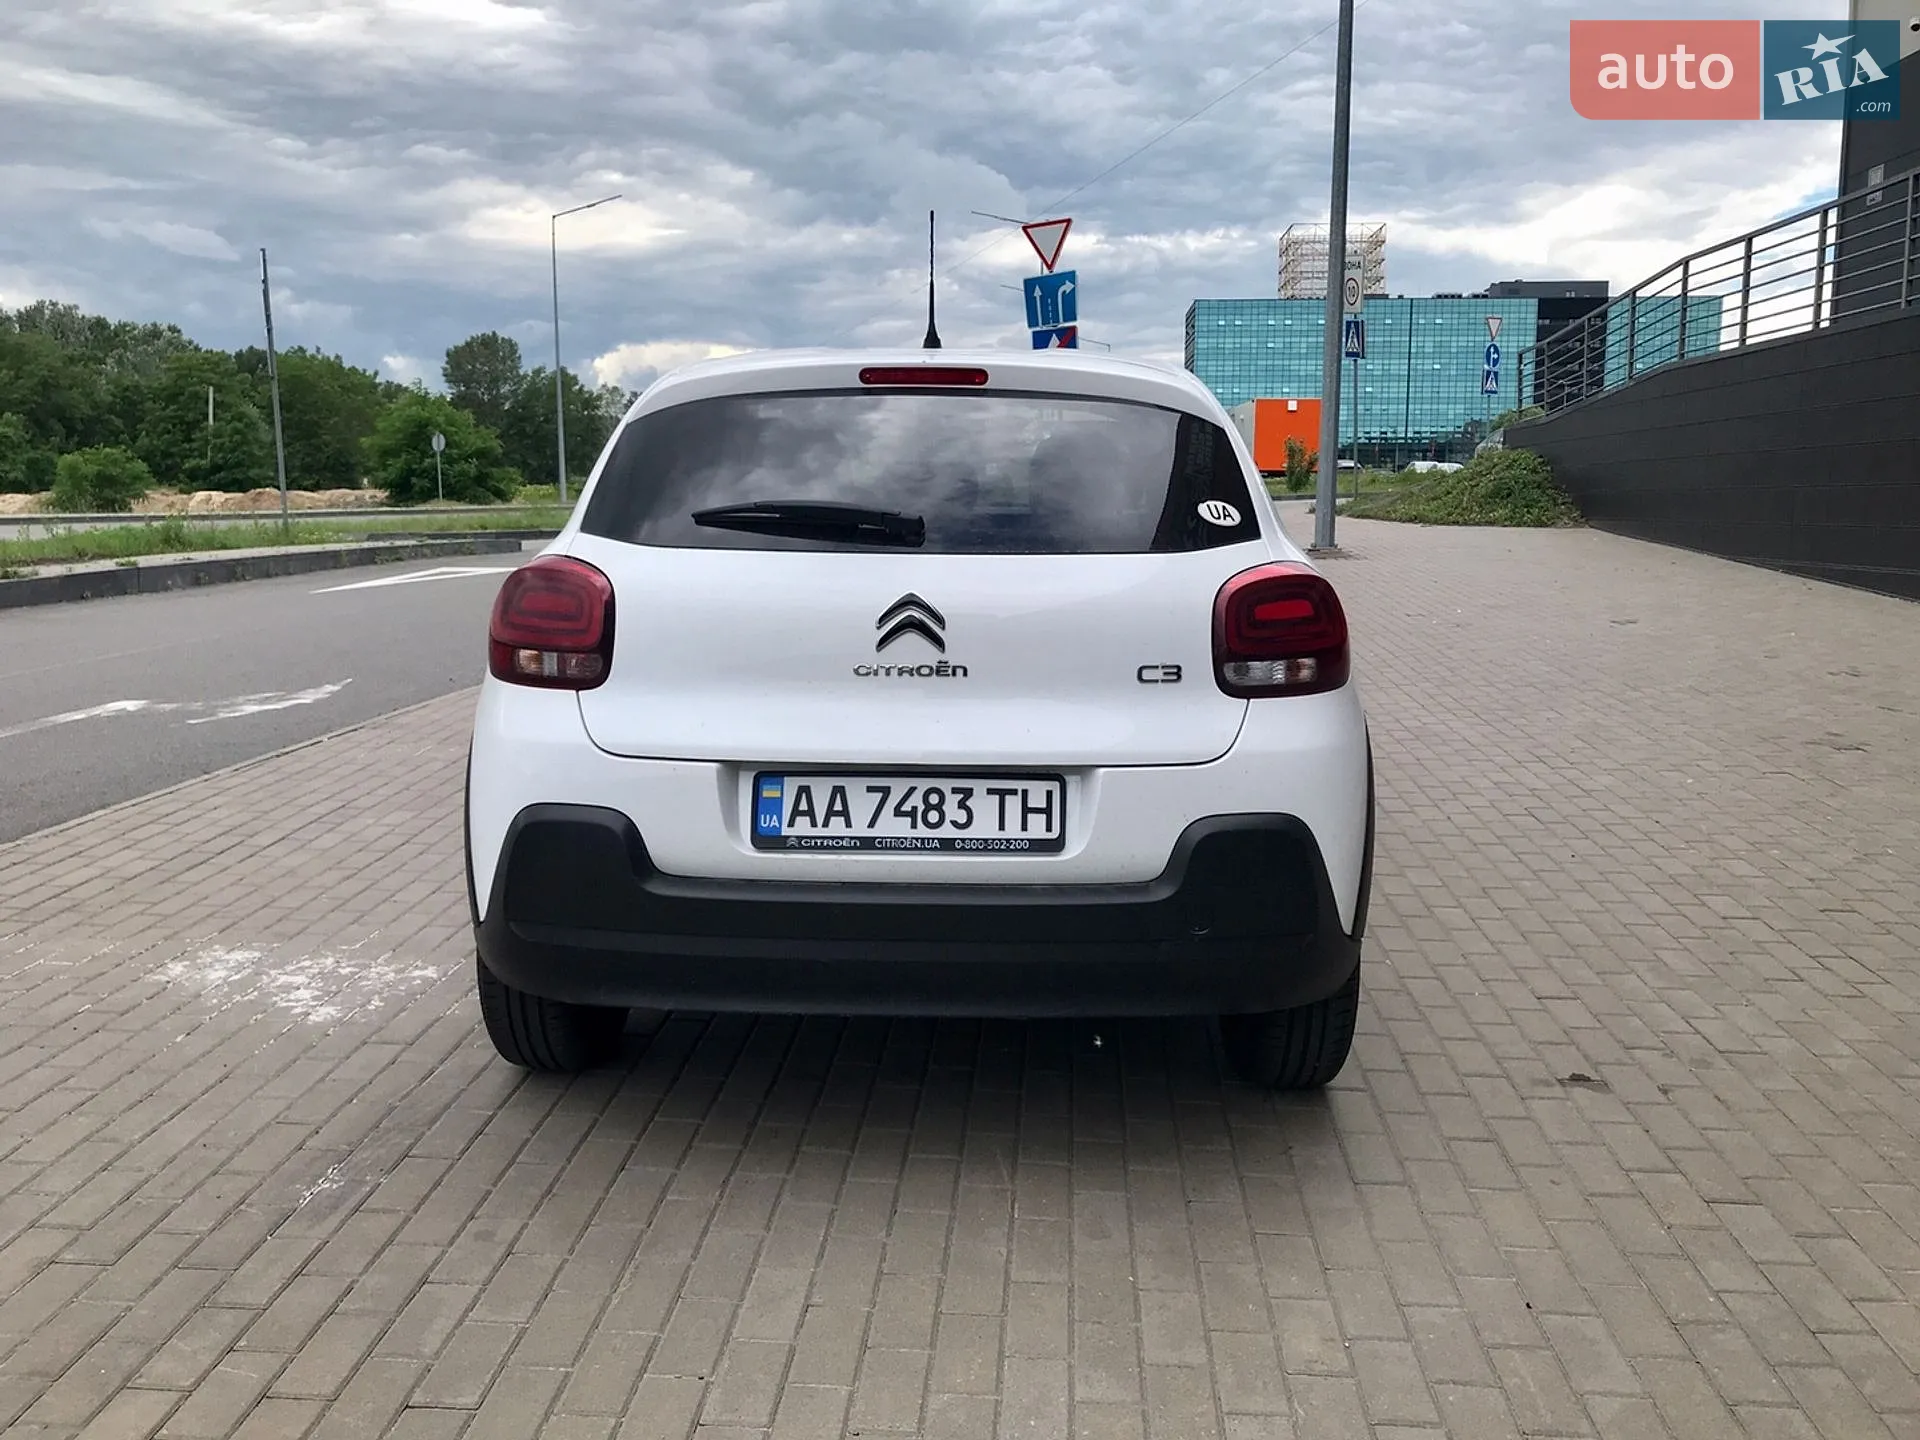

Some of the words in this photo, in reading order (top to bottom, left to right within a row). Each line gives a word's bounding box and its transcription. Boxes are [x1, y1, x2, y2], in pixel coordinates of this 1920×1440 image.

[1206, 504, 1235, 522] UA
[1136, 664, 1183, 684] C3
[786, 785, 852, 829] AA
[865, 785, 974, 830] 7483
[986, 788, 1053, 833] TH
[760, 814, 780, 829] UA
